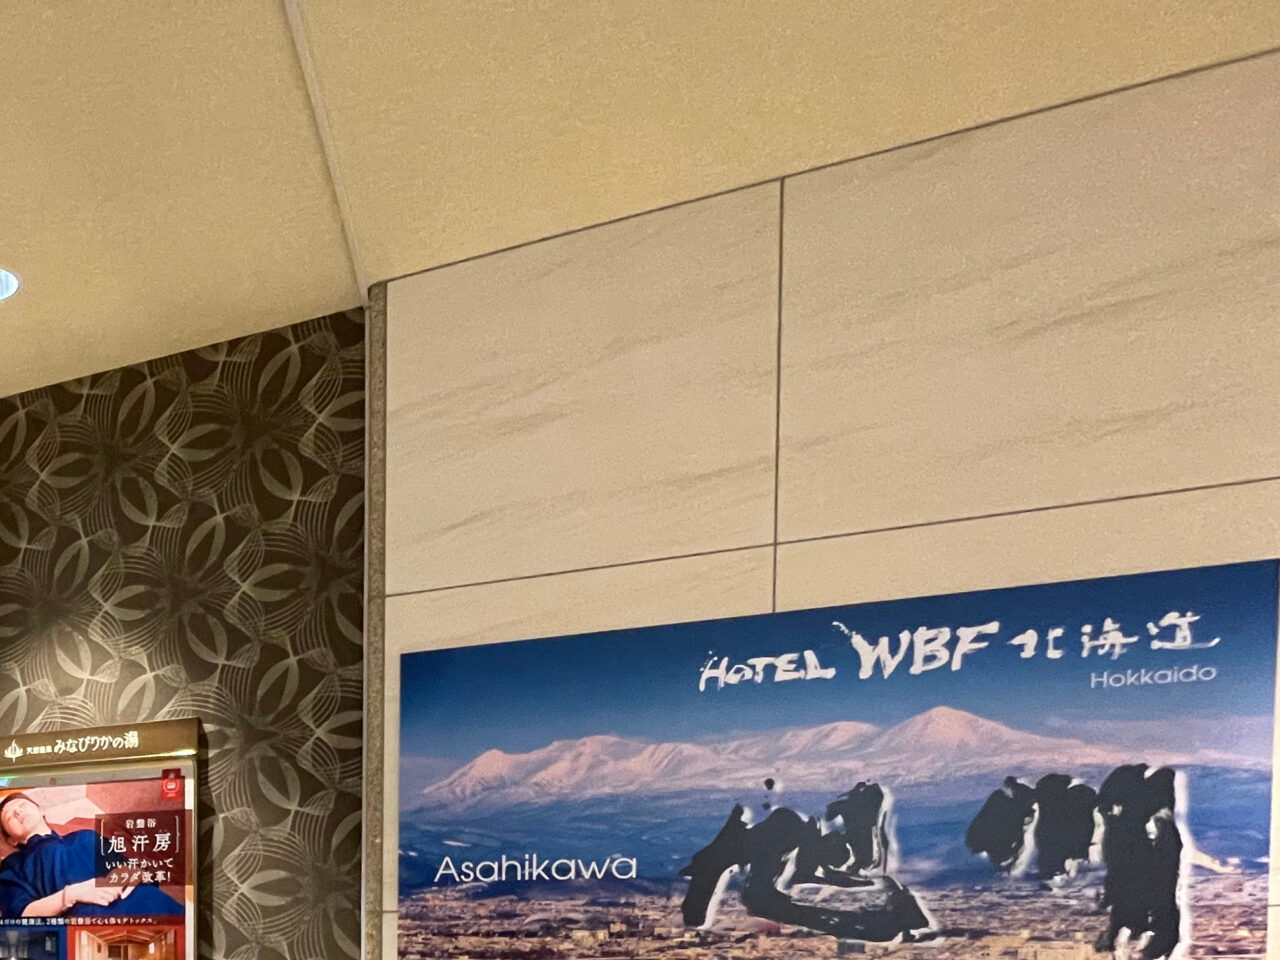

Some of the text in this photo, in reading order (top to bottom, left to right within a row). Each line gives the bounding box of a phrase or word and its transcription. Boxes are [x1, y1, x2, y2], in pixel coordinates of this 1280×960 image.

[699, 611, 1221, 692] HOTEL WBF 北海道
[1090, 665, 1217, 688] Hokkaido
[125, 818, 157, 829] 岩盤浴
[107, 832, 171, 853] 旭汗房
[105, 857, 173, 870] いい汗かいて
[434, 854, 637, 882] Asahikawa
